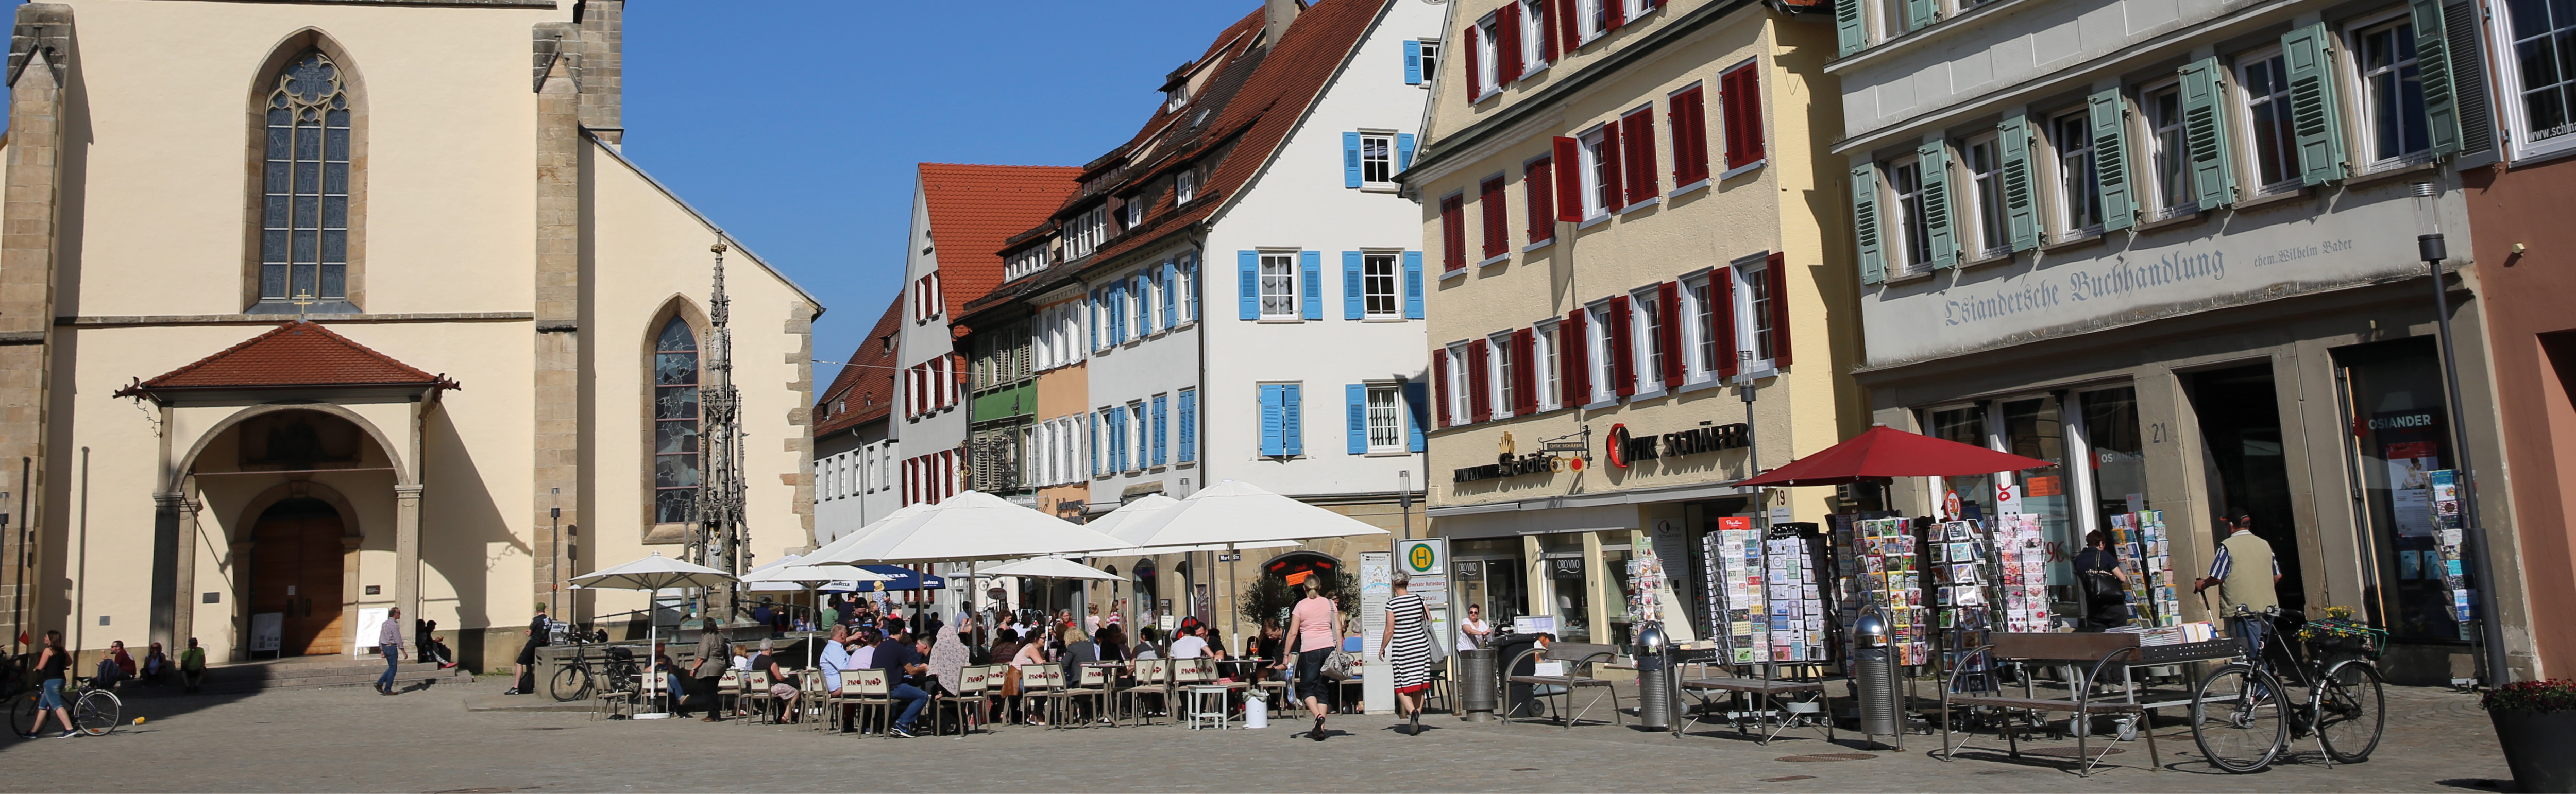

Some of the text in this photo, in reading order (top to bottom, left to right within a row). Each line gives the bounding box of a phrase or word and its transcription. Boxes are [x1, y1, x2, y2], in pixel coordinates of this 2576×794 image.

[2278, 245, 2318, 263] Wilhelm
[2322, 239, 2352, 254] Bader
[1944, 250, 2224, 327] Osiandersche Buchhandlung
[2368, 414, 2432, 430] OSIANDER
[1662, 420, 1750, 457] SCHÄFER
[2151, 422, 2167, 443] 21
[1775, 490, 1785, 506] 19
[1416, 550, 1427, 565] H
[1557, 559, 1580, 569] ORO VIVO
[1458, 562, 1477, 572] ORO VIVO
